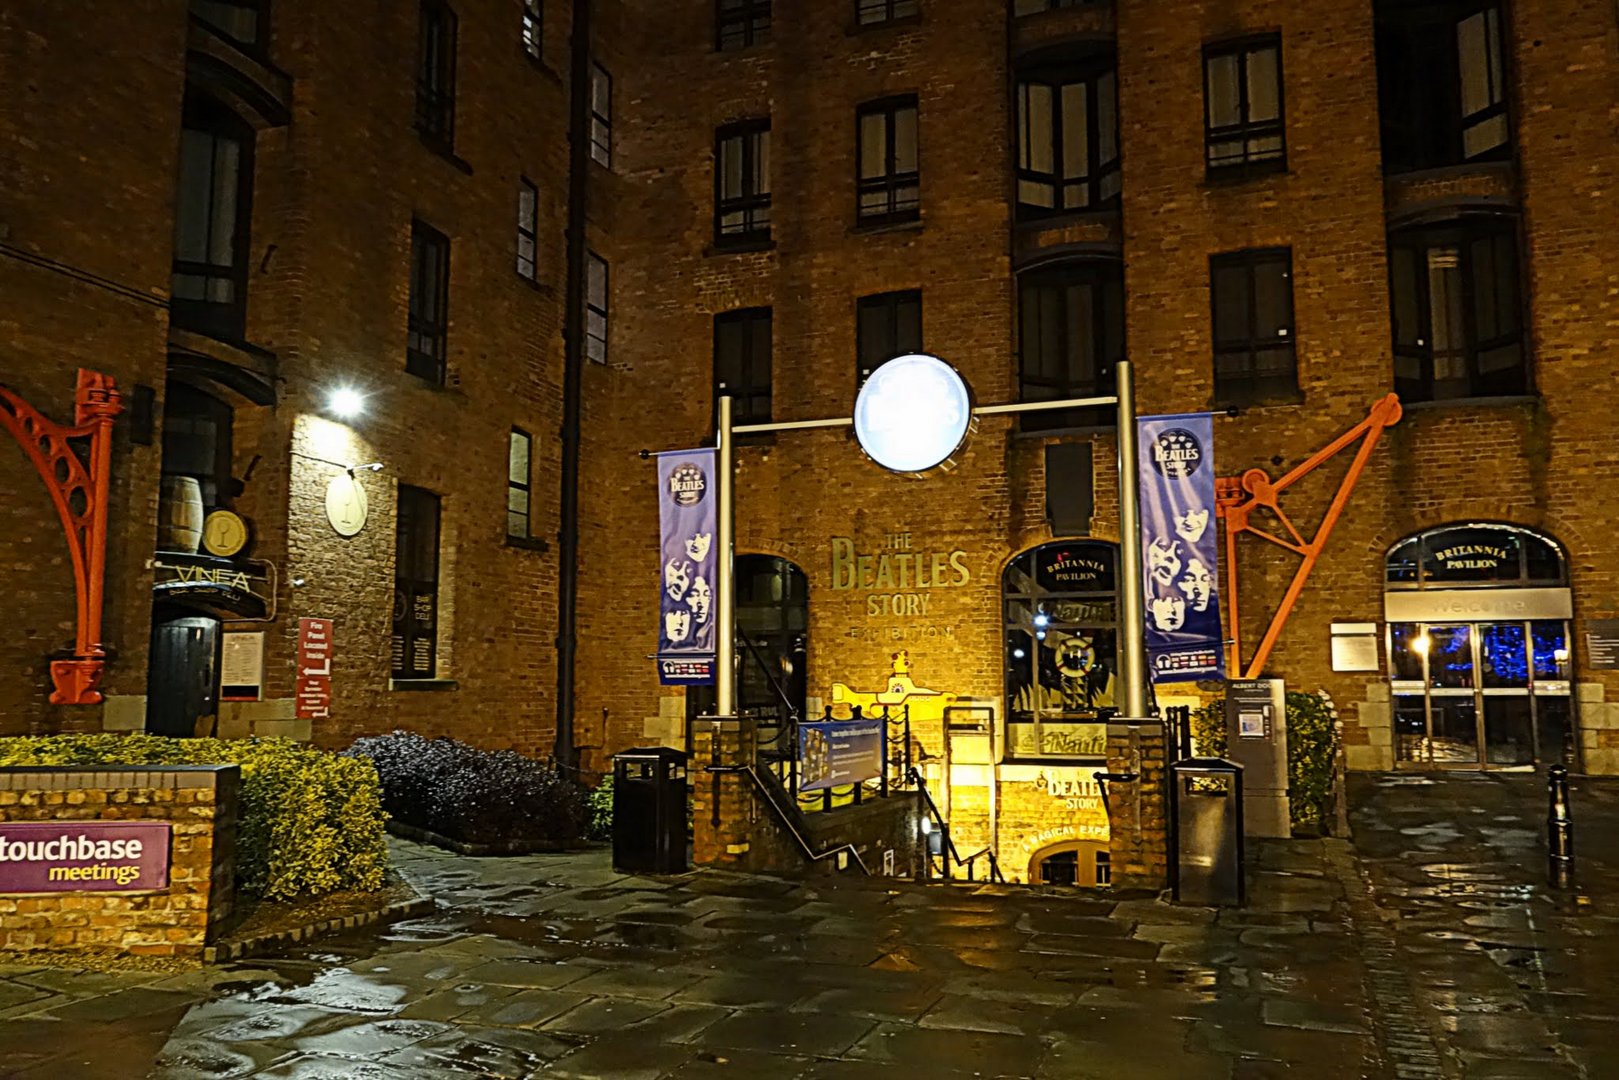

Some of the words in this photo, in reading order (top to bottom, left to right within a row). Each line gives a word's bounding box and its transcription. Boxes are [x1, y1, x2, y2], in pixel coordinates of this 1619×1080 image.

[1155, 445, 1199, 462] BEATLES
[671, 477, 704, 492] BEATLES
[885, 533, 912, 549] THE
[1435, 545, 1506, 560] BRITANNIA
[832, 537, 970, 590] BEATLES
[1047, 560, 1104, 573] BRITANNIA
[1446, 560, 1497, 569] PAVILION
[176, 565, 250, 593] VINEA
[867, 593, 930, 617] STORY
[851, 627, 951, 640] EXHIBITION
[1066, 798, 1098, 809] STORY
[1030, 825, 1076, 845] MAGICAL
[0, 835, 143, 861] touchbase
[49, 862, 140, 885] meetings
